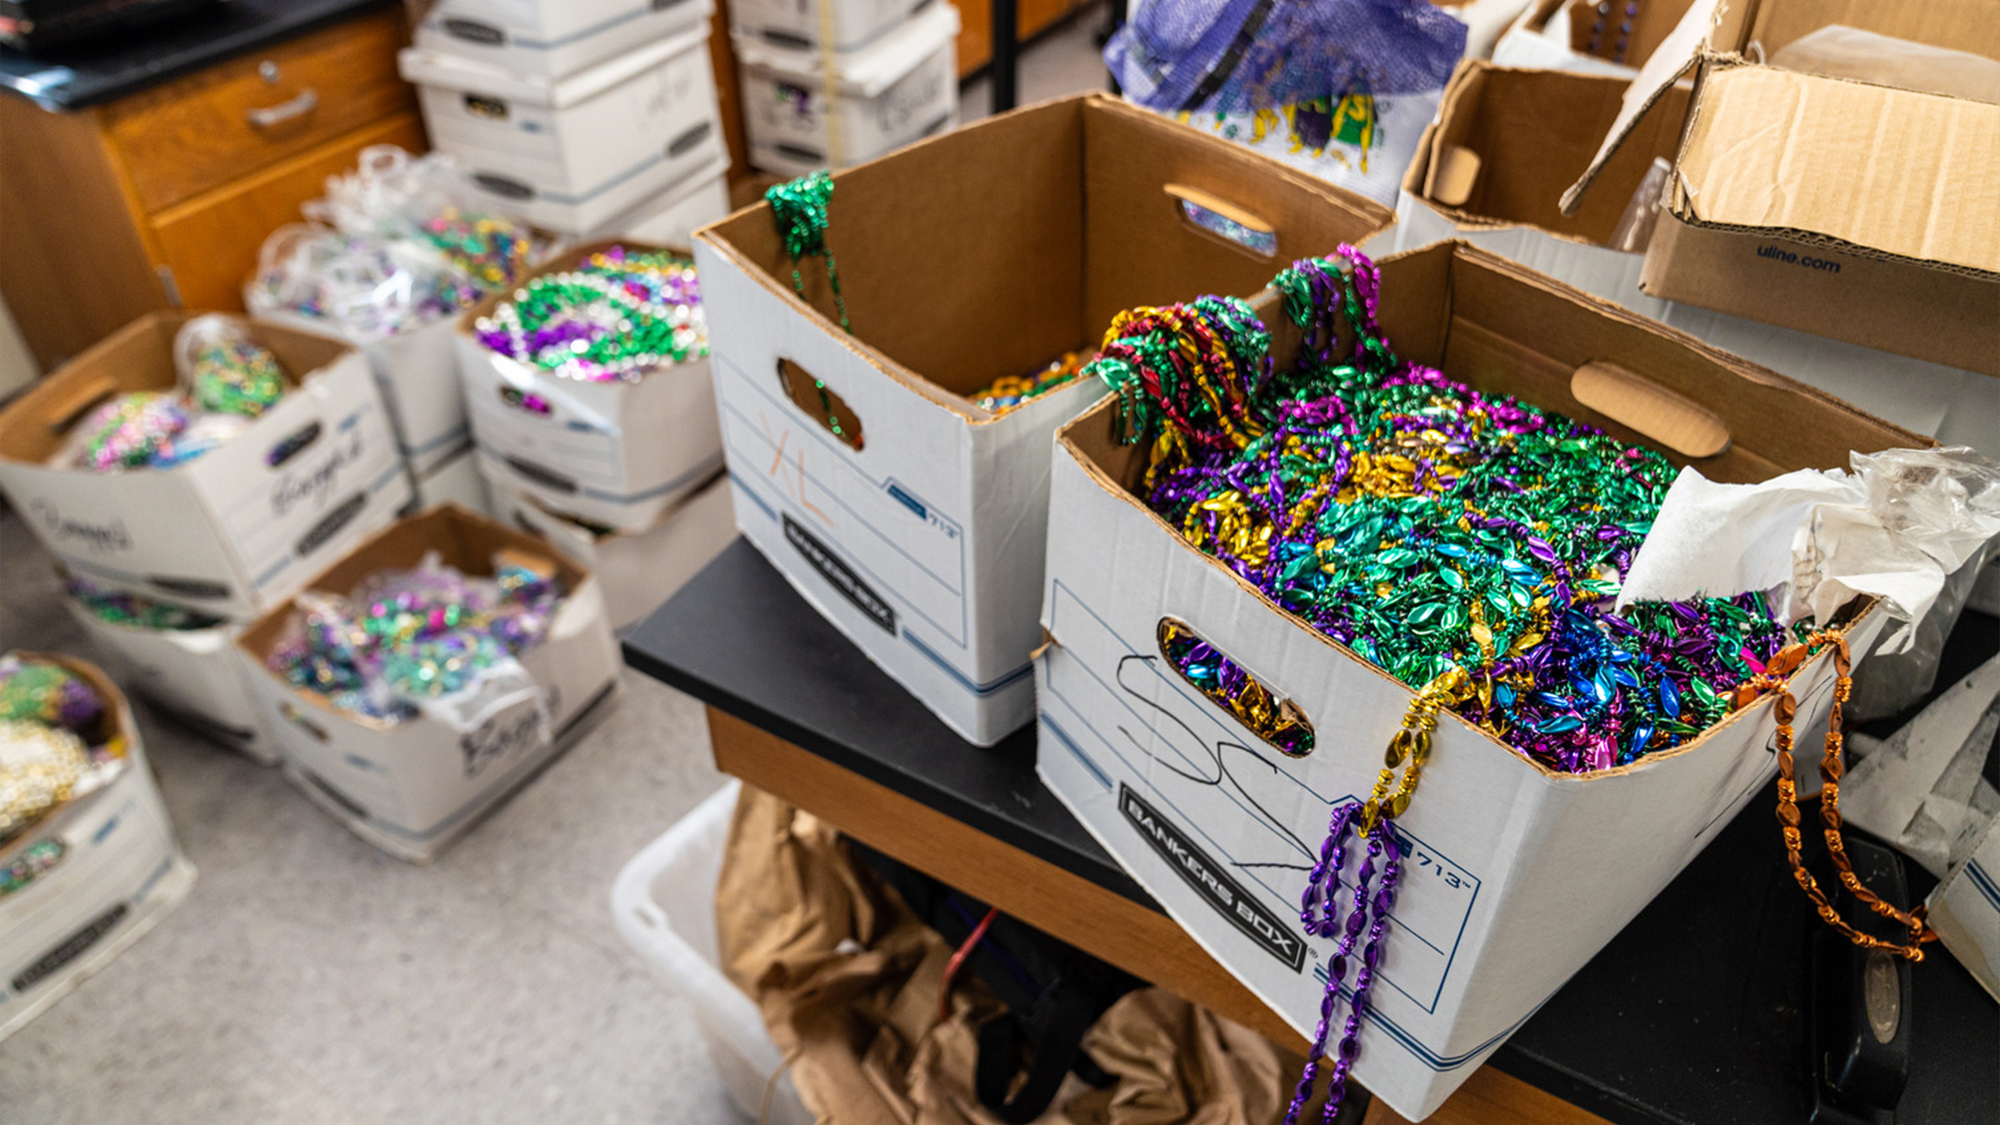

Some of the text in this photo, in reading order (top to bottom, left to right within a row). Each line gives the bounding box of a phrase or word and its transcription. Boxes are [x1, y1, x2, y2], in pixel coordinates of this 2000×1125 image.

[1757, 245, 1841, 273] uline.com
[759, 409, 837, 528] XL
[1117, 654, 1319, 870] SC
[1127, 798, 1293, 956] BANKERS BOX
